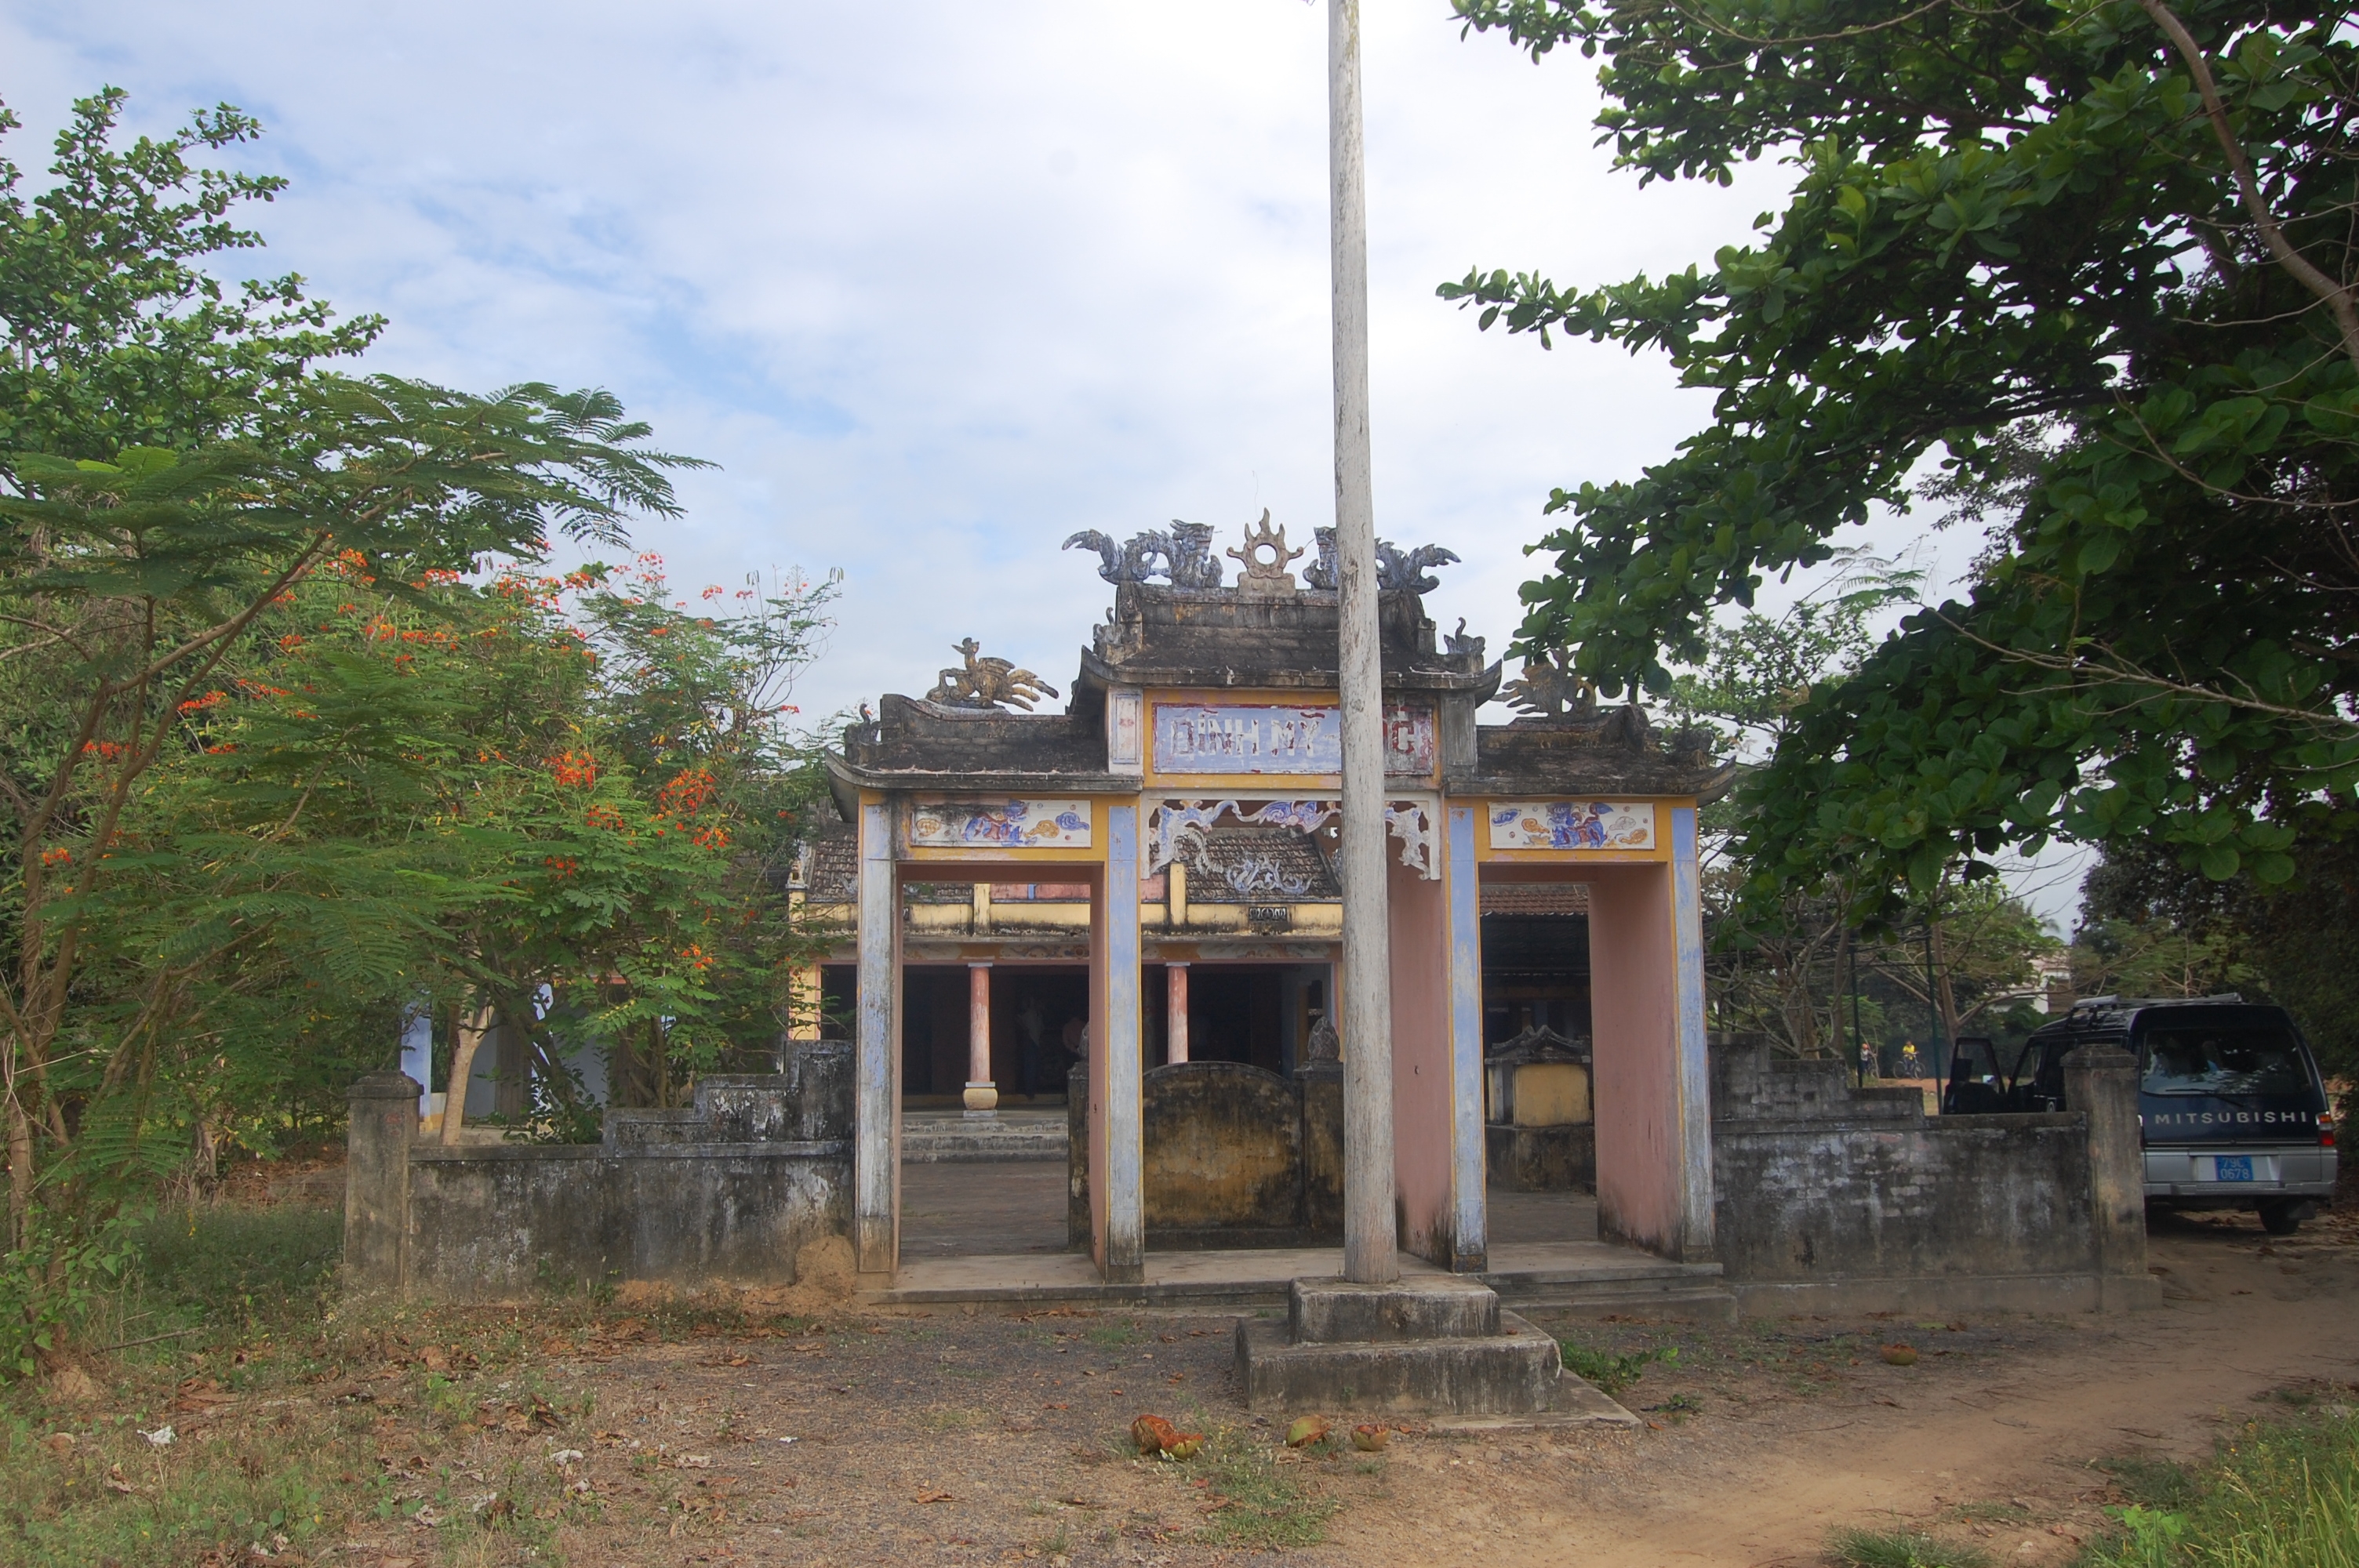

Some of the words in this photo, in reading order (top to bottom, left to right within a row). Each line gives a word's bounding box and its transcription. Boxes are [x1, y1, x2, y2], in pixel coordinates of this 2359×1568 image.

[2155, 1111, 2307, 1124] MITSUBISHI
[2222, 1157, 2244, 1168] 79C
[2220, 1168, 2249, 1179] 0678
